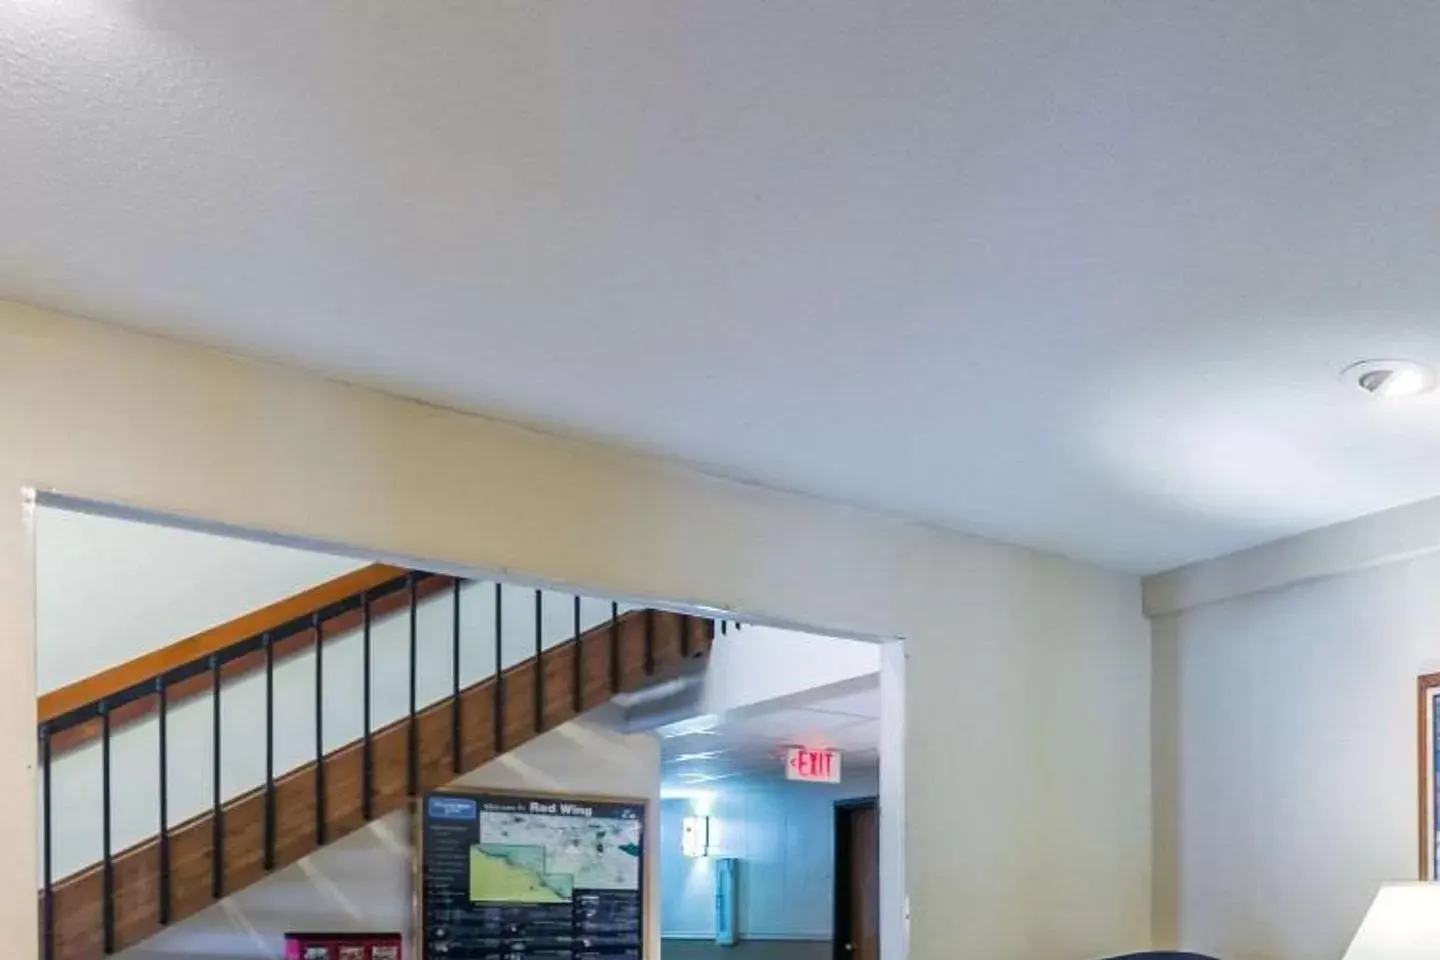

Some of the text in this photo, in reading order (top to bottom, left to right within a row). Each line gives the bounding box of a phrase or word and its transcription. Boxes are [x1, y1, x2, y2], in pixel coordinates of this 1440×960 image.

[798, 751, 834, 776] EXIT
[529, 802, 557, 814] Red
[559, 803, 593, 817] Wing
